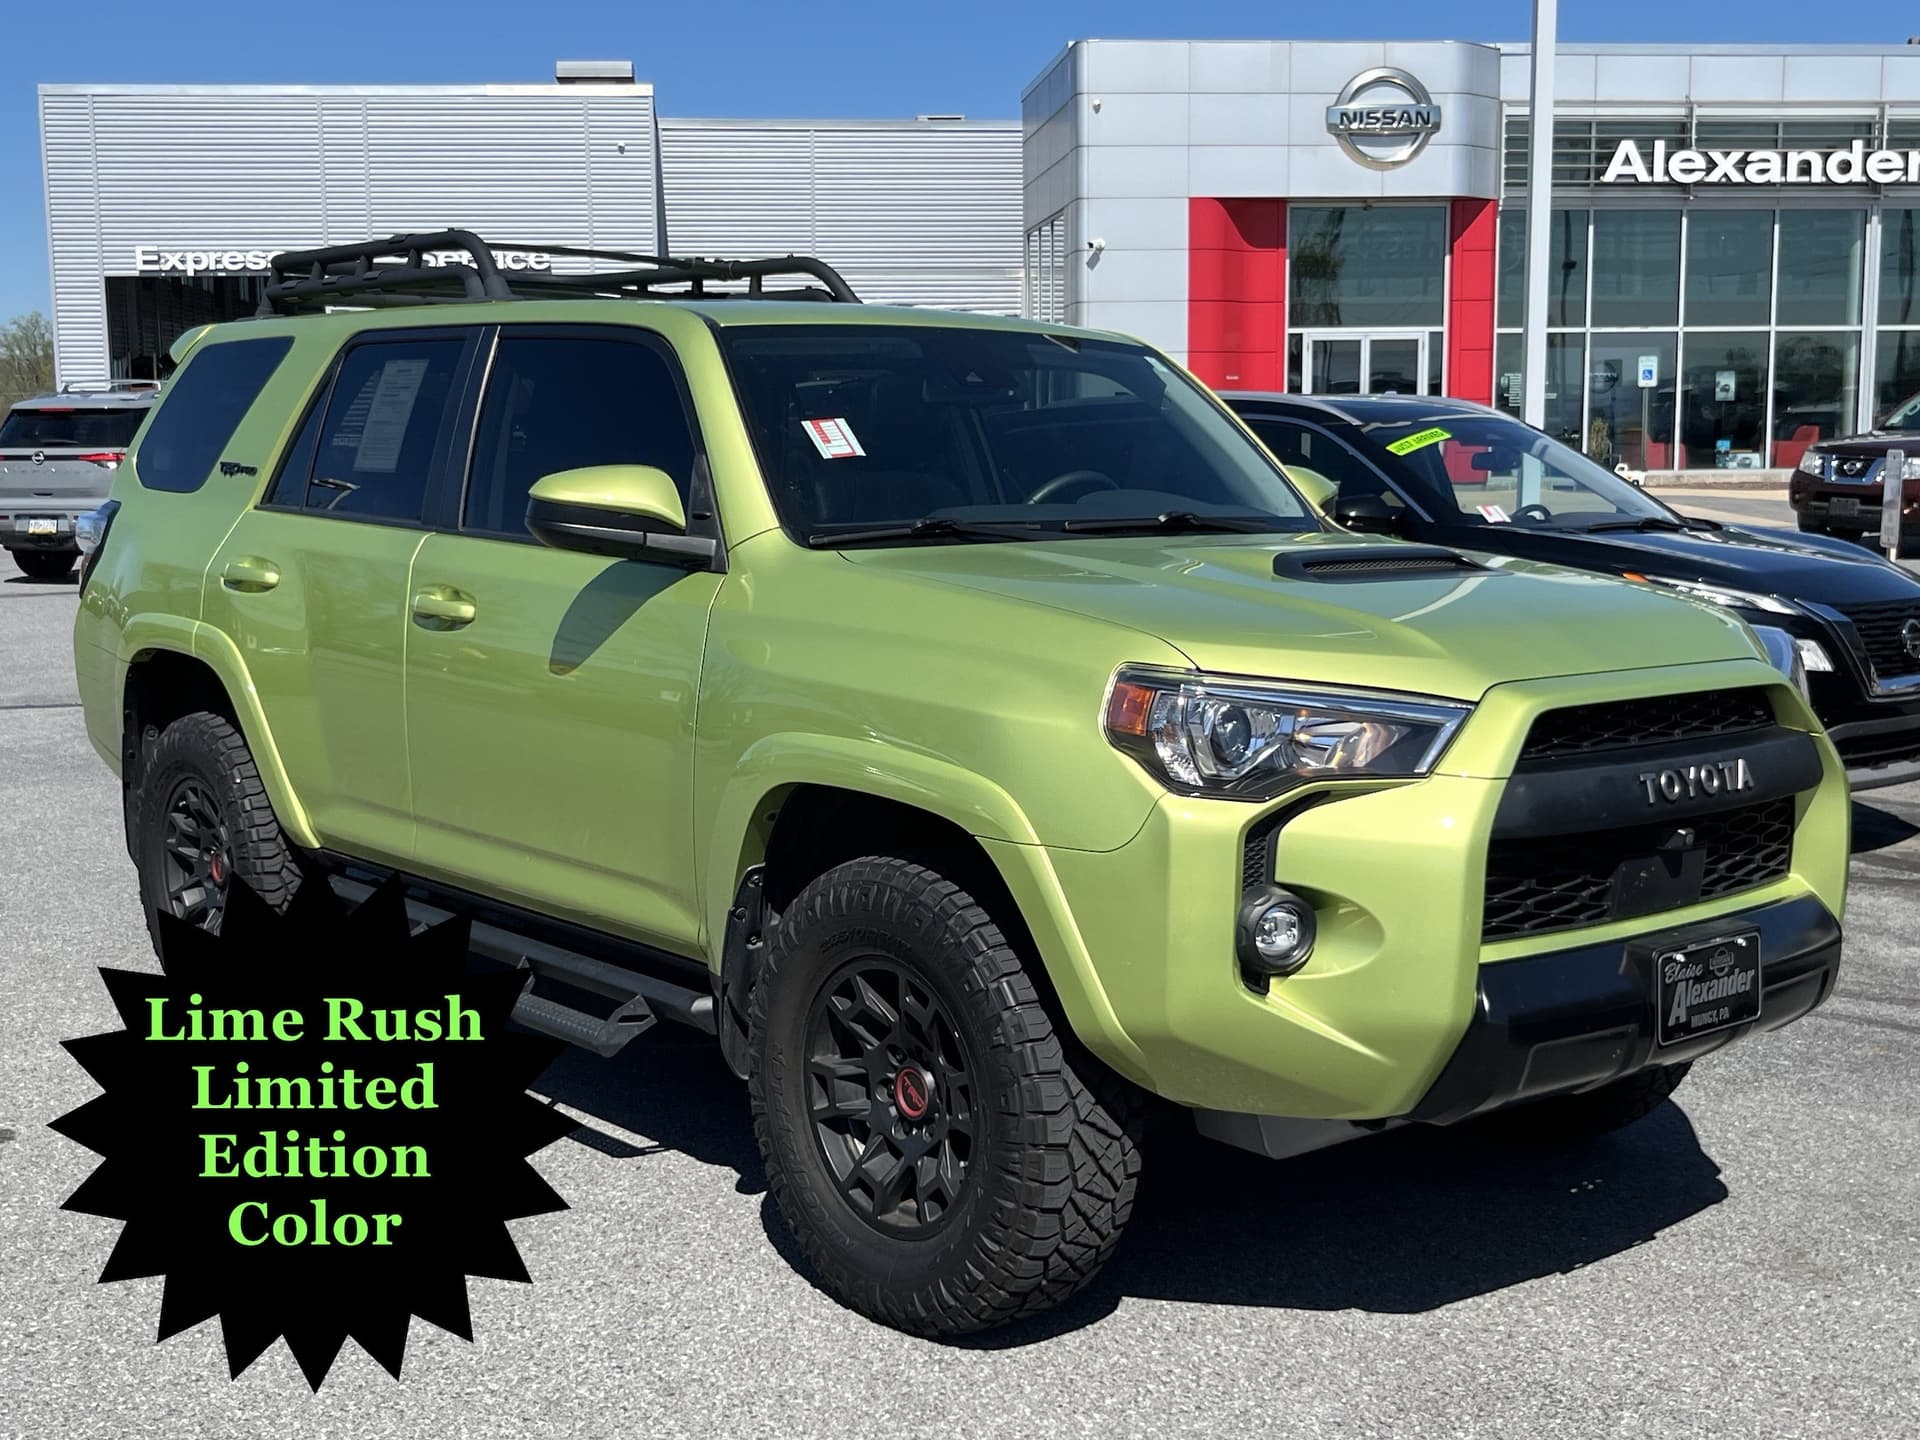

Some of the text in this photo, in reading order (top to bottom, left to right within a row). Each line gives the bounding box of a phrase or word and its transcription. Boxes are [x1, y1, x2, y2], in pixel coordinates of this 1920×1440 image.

[1338, 110, 1432, 129] NISSAN
[1602, 139, 1920, 184] Alexander
[421, 248, 550, 271] Serice
[1639, 758, 1755, 804] TOYOTA
[1664, 962, 1703, 984] Blaise
[1667, 967, 1755, 1027] Alexander
